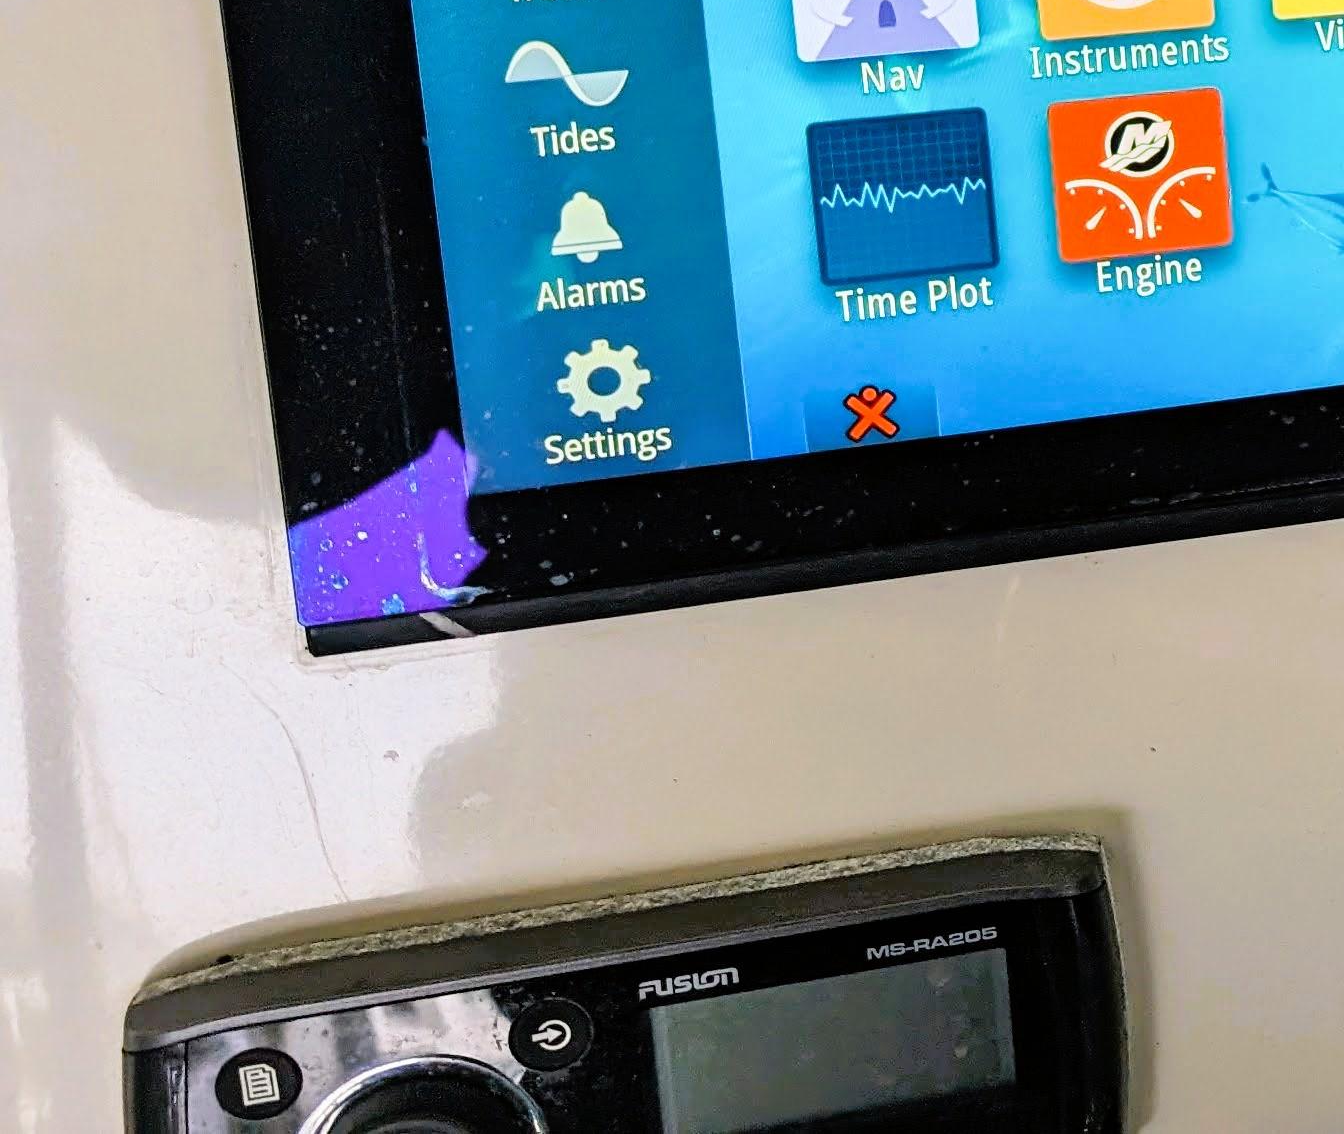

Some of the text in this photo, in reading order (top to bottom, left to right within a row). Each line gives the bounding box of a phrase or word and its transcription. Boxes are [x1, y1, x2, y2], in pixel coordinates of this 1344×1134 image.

[1030, 32, 1229, 78] Instruments
[860, 61, 924, 93] Nav
[530, 122, 615, 157] Tides
[536, 275, 646, 311] Alarms
[1096, 255, 1202, 296] Engine
[835, 276, 993, 323] Time Plot
[544, 425, 672, 465] Settings
[866, 927, 998, 960] MS-RA205
[638, 967, 740, 1003] FUSION
